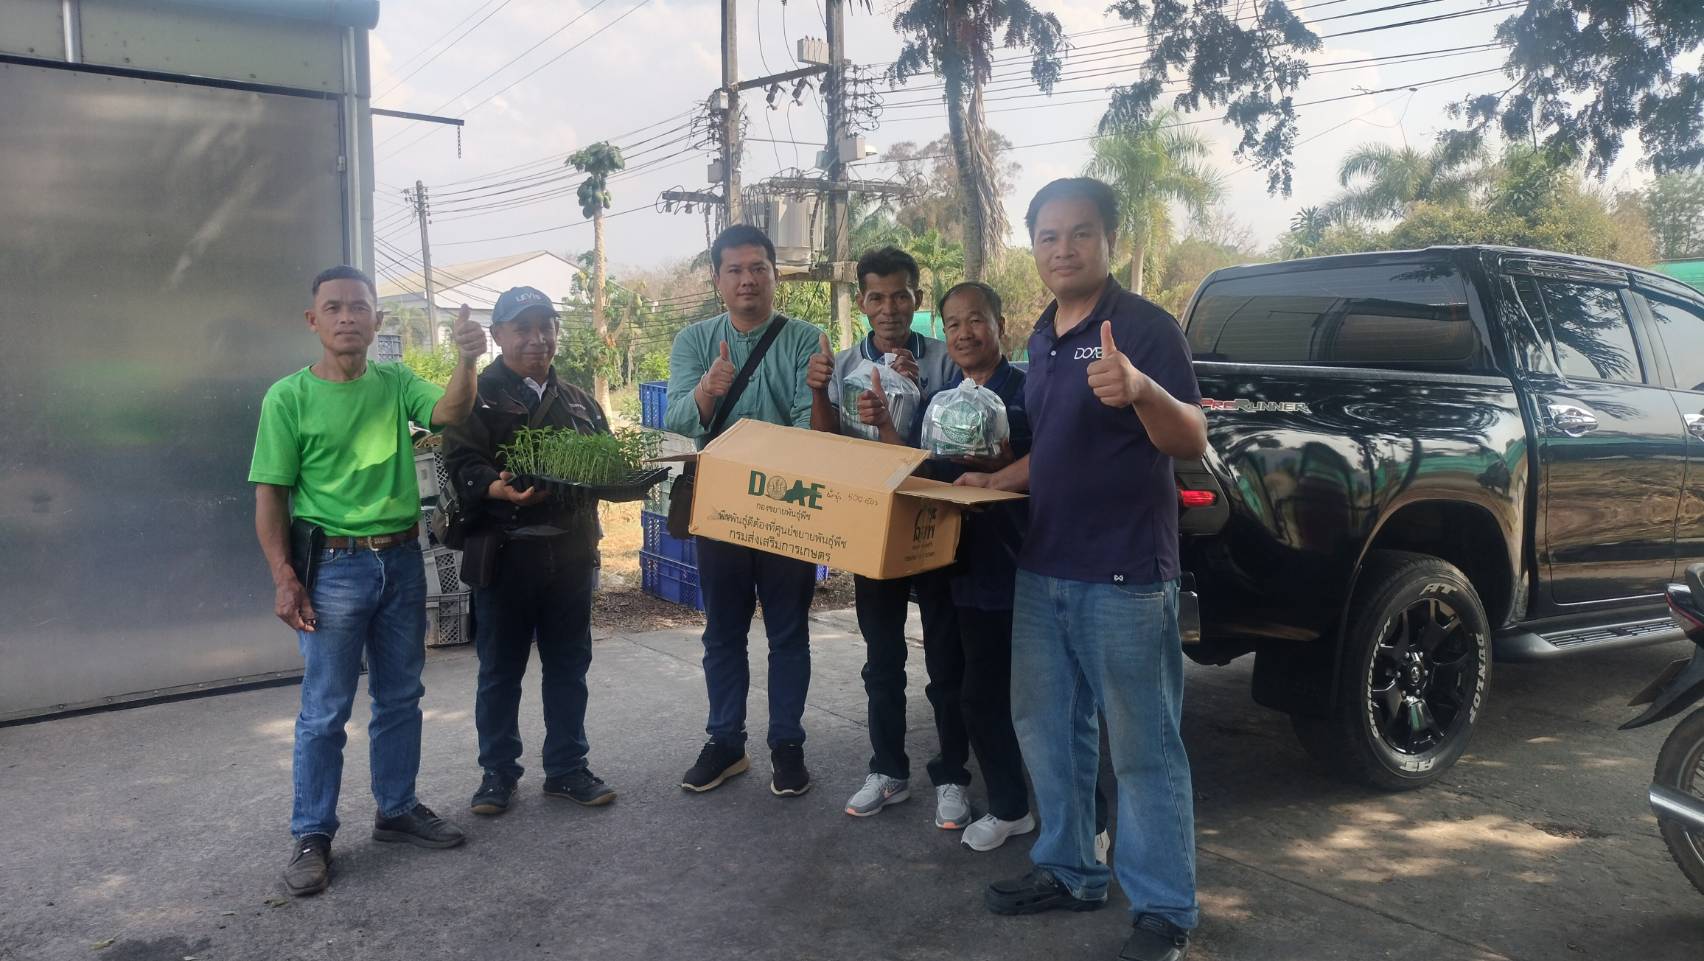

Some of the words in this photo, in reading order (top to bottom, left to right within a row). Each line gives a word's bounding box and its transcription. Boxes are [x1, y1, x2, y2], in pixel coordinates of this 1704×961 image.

[729, 529, 831, 562] กรมส่งเสริมการเกษตร
[1469, 632, 1485, 724] DUNLOP
